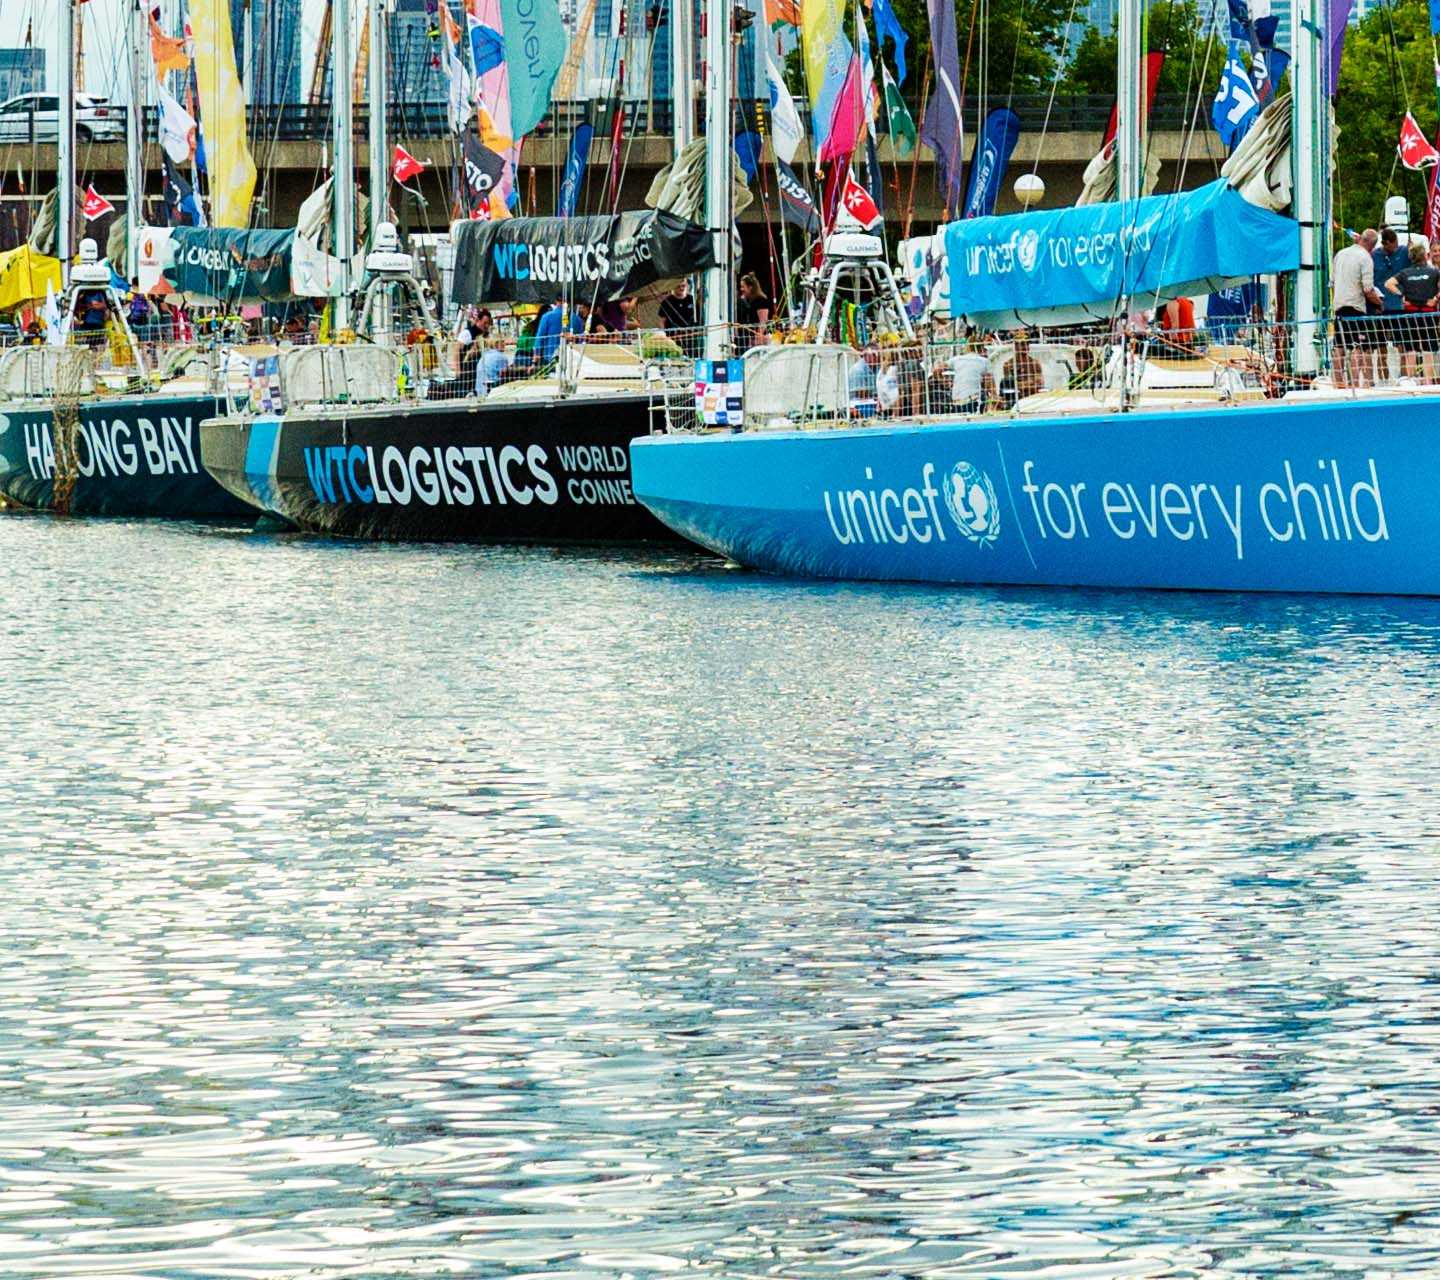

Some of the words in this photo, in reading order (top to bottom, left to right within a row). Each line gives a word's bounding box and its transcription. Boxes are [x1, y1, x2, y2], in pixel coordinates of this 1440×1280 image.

[137, 416, 200, 476] BAY
[556, 444, 628, 474] WORLD
[823, 462, 947, 546] unicef
[1023, 459, 1090, 541] for
[1102, 478, 1244, 561] every
[1260, 458, 1391, 542] child
